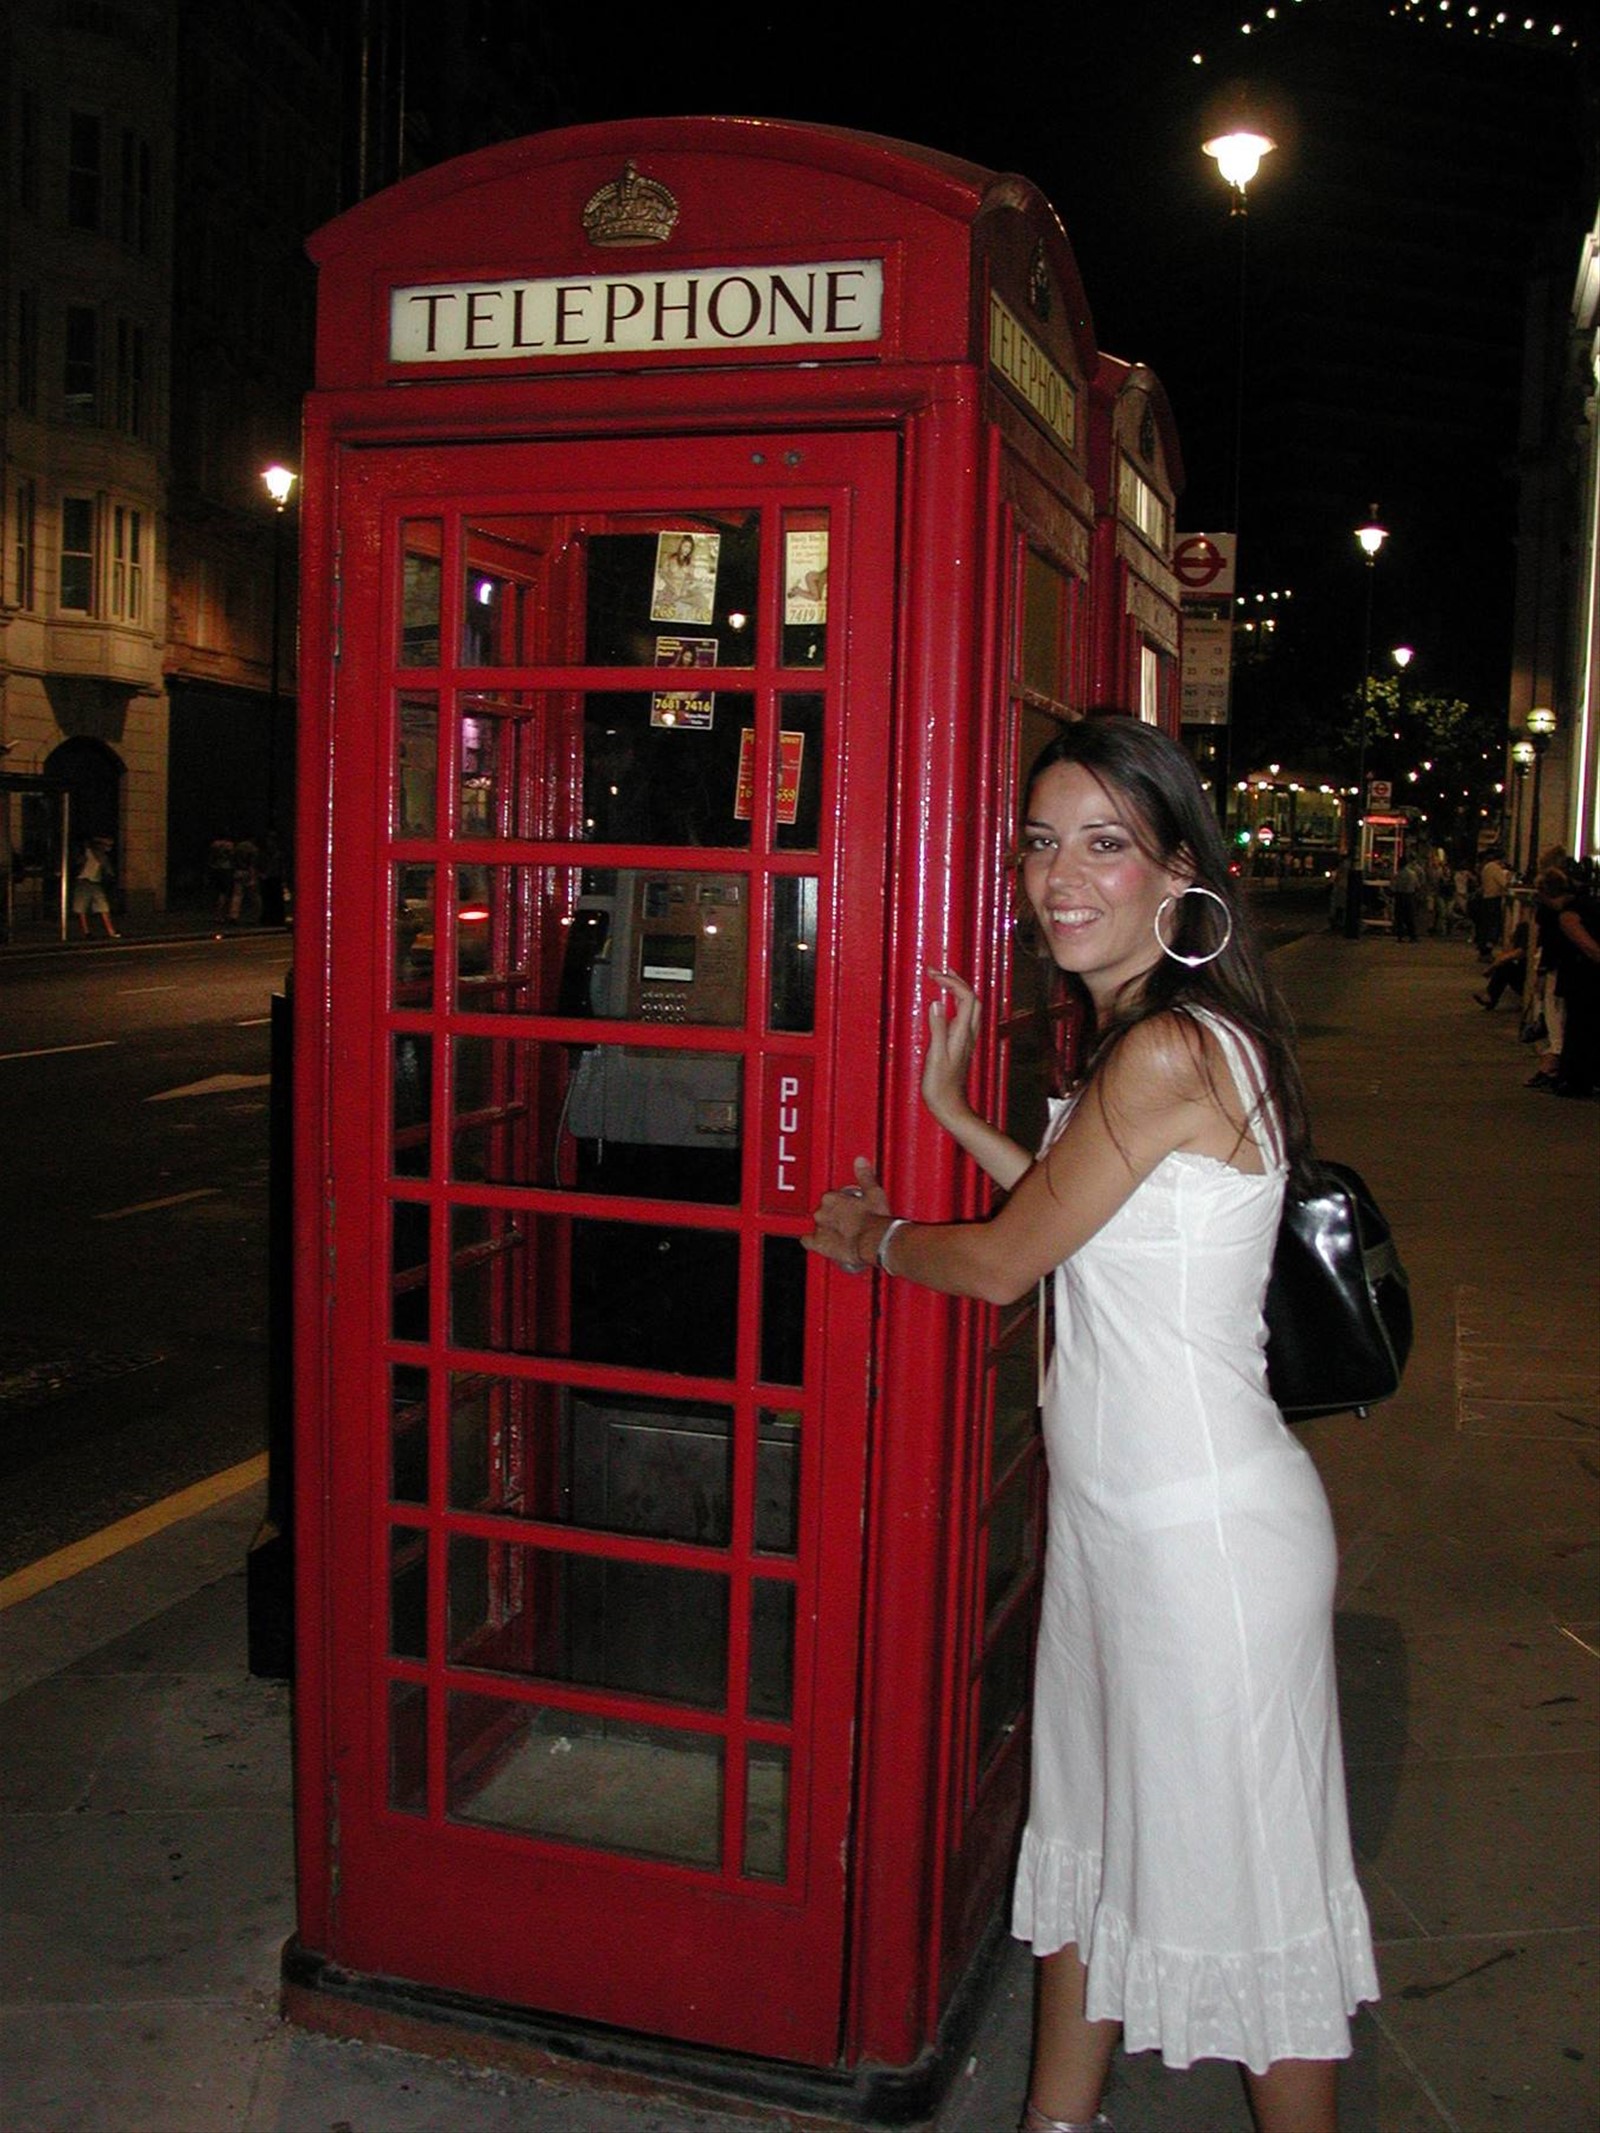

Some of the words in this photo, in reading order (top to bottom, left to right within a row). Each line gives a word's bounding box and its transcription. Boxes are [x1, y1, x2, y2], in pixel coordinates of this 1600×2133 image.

[409, 270, 866, 352] TELEPHONE
[990, 299, 1073, 445] TELEPHONE
[777, 1077, 799, 1191] PULL
